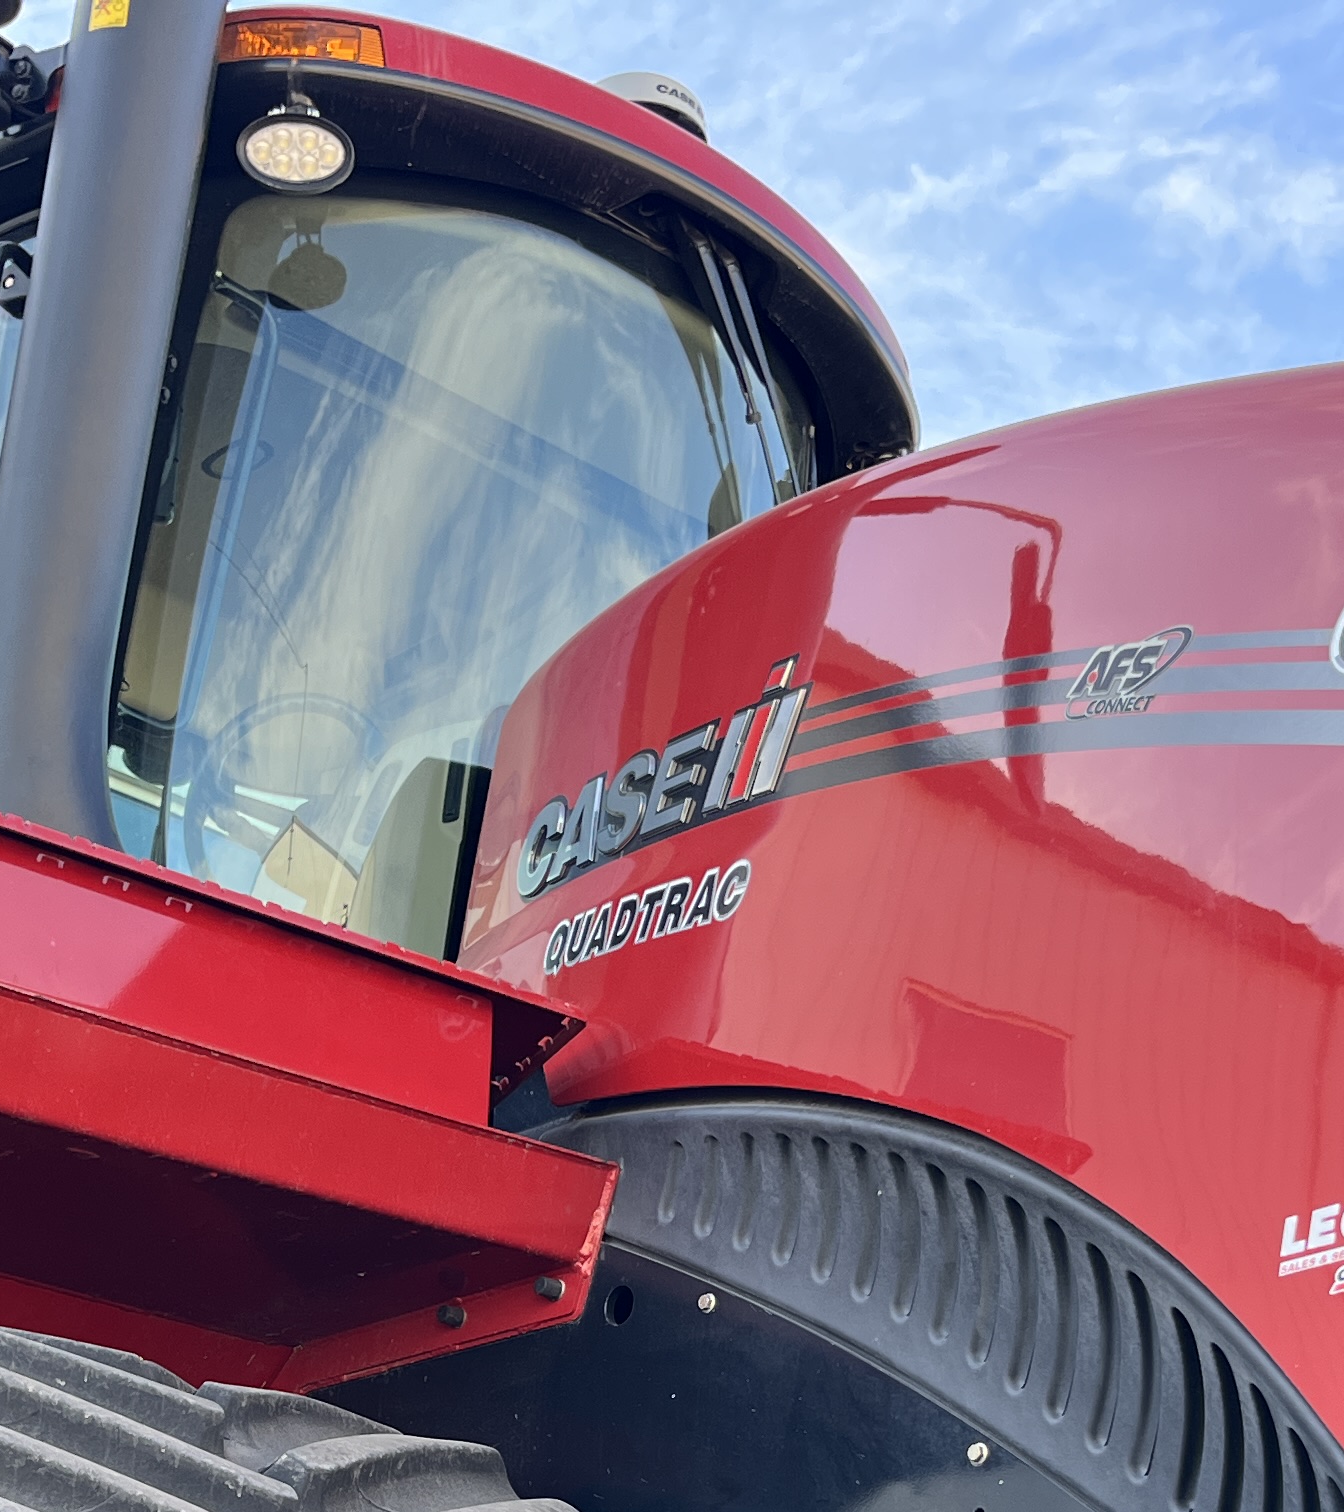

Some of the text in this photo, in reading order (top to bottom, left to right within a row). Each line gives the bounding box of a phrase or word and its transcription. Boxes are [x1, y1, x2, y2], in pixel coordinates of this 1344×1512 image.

[1066, 641, 1168, 698] AFS
[1086, 695, 1155, 715] CONNECT
[517, 718, 721, 902] CASE
[543, 858, 752, 976] QUADTRAC
[1280, 1257, 1316, 1274] SALES
[1319, 1254, 1328, 1264] &
